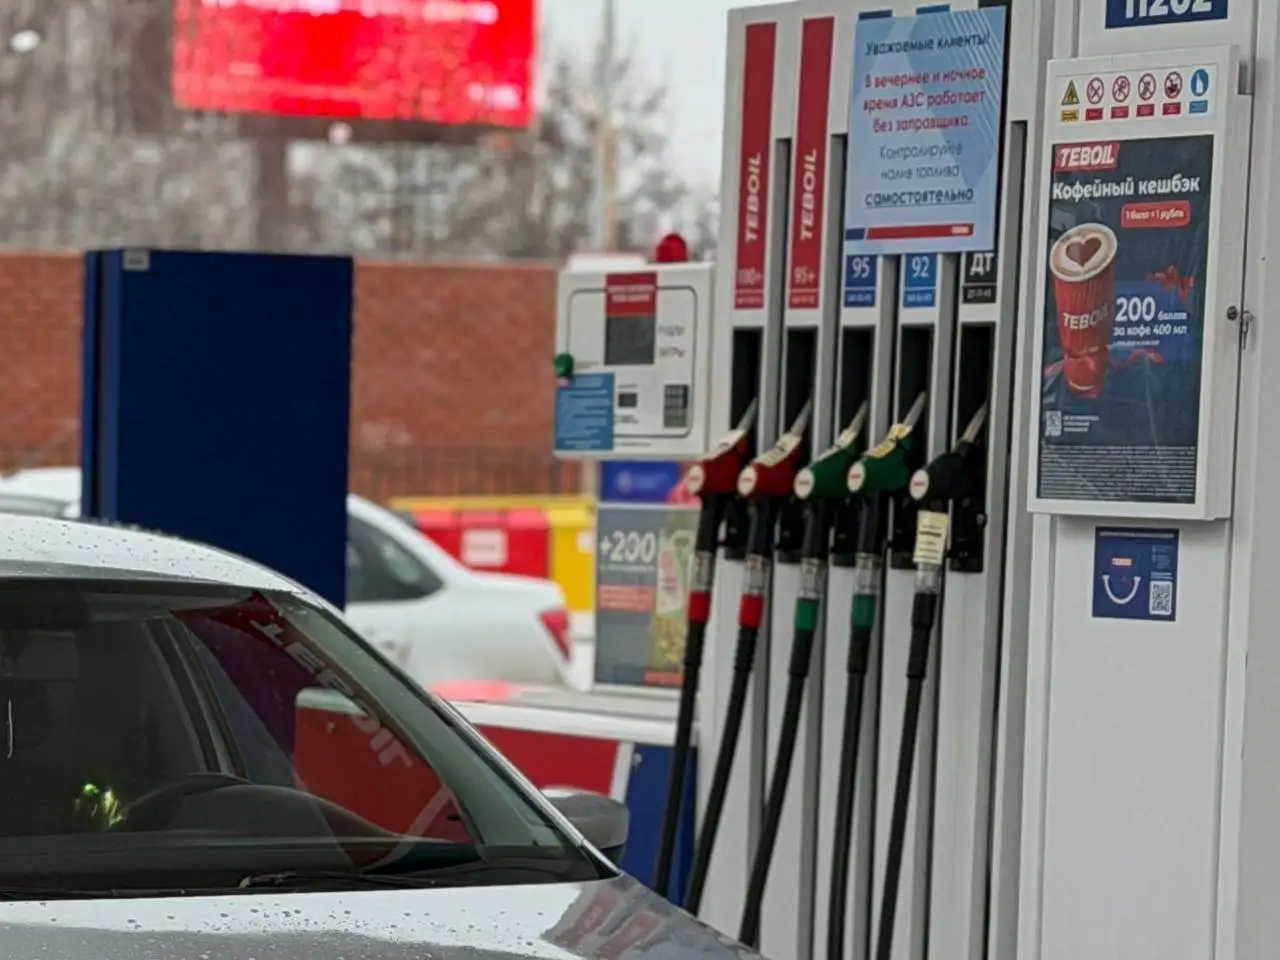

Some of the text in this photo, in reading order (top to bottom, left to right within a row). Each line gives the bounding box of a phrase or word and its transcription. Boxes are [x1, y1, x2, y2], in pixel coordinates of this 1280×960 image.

[865, 29, 990, 55] Уважаемые клиенты!
[865, 68, 985, 88] В вечернее и ночное
[864, 90, 986, 114] время АЗС работает
[873, 118, 893, 133] без
[880, 140, 962, 160] Контролируйте
[1059, 144, 1115, 168] TEBOIL
[881, 165, 960, 181] налив топлива
[745, 152, 761, 243] TEBOIL
[800, 148, 817, 241] TEBOIL
[865, 188, 974, 207] самостоятельно
[1052, 173, 1200, 203] Кофейный кешбэк
[852, 257, 870, 279] 95
[912, 256, 929, 278] 92
[970, 253, 994, 276] ДТ
[1115, 296, 1155, 322] 200
[1113, 326, 1125, 336] за
[1127, 324, 1151, 338] кофе
[1153, 324, 1171, 335] 400
